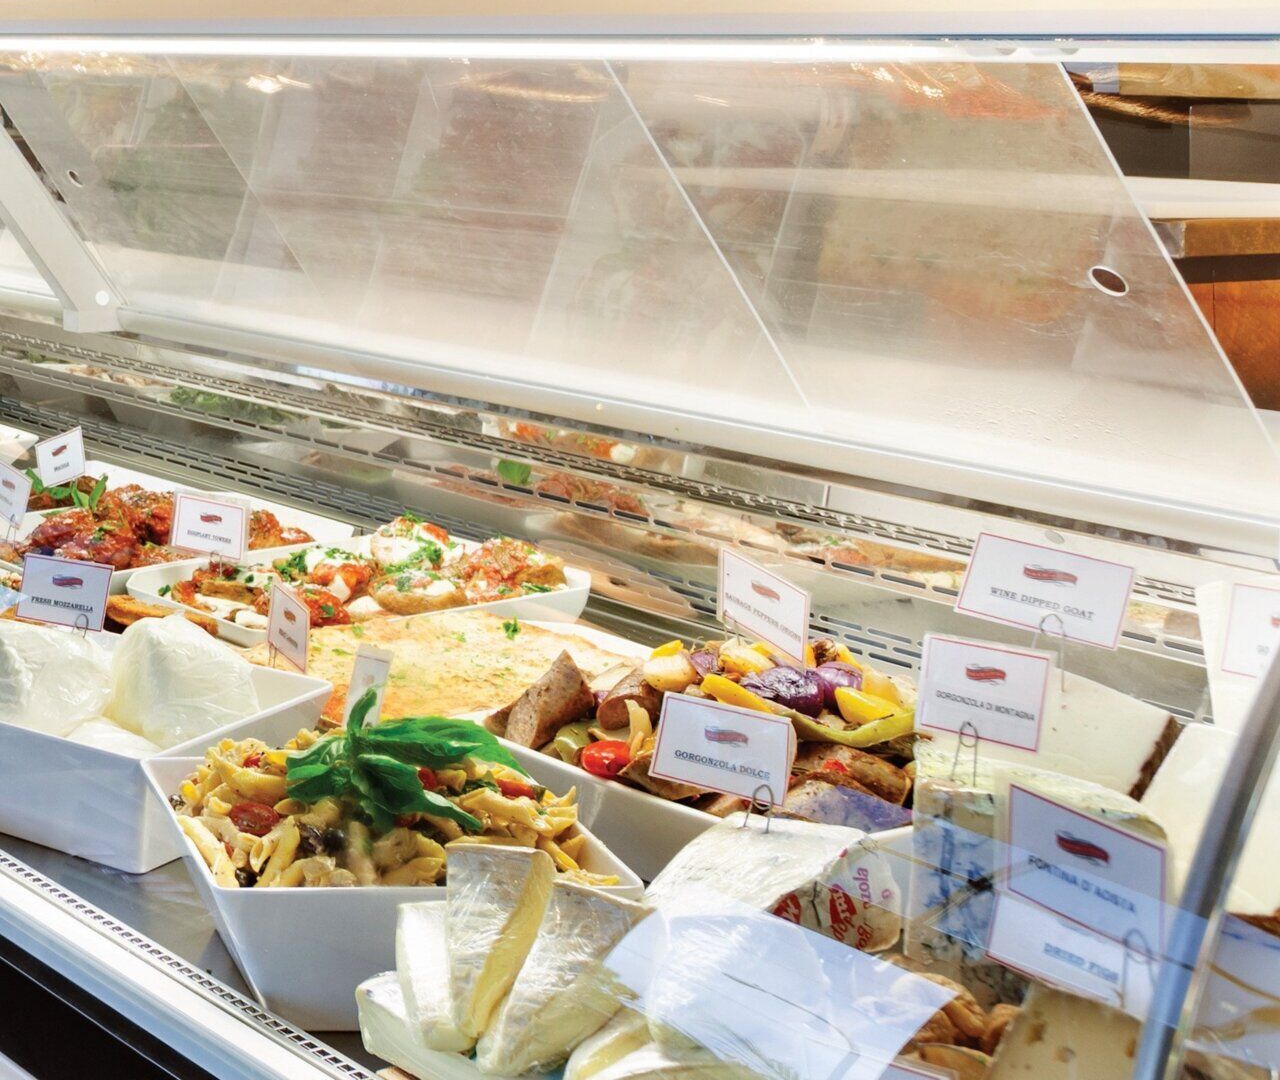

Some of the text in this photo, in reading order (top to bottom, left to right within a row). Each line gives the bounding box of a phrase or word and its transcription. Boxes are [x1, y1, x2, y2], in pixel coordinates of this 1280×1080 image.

[31, 596, 94, 613] FRESH MOZZARELLA
[990, 586, 1094, 621] WINE DIPPED GOAT
[935, 689, 984, 709] GORGONZOLA
[994, 704, 1035, 721] MONTAGNA
[674, 750, 770, 779] GORGONZOLA DOLCE
[1028, 854, 1079, 886] FONTINA
